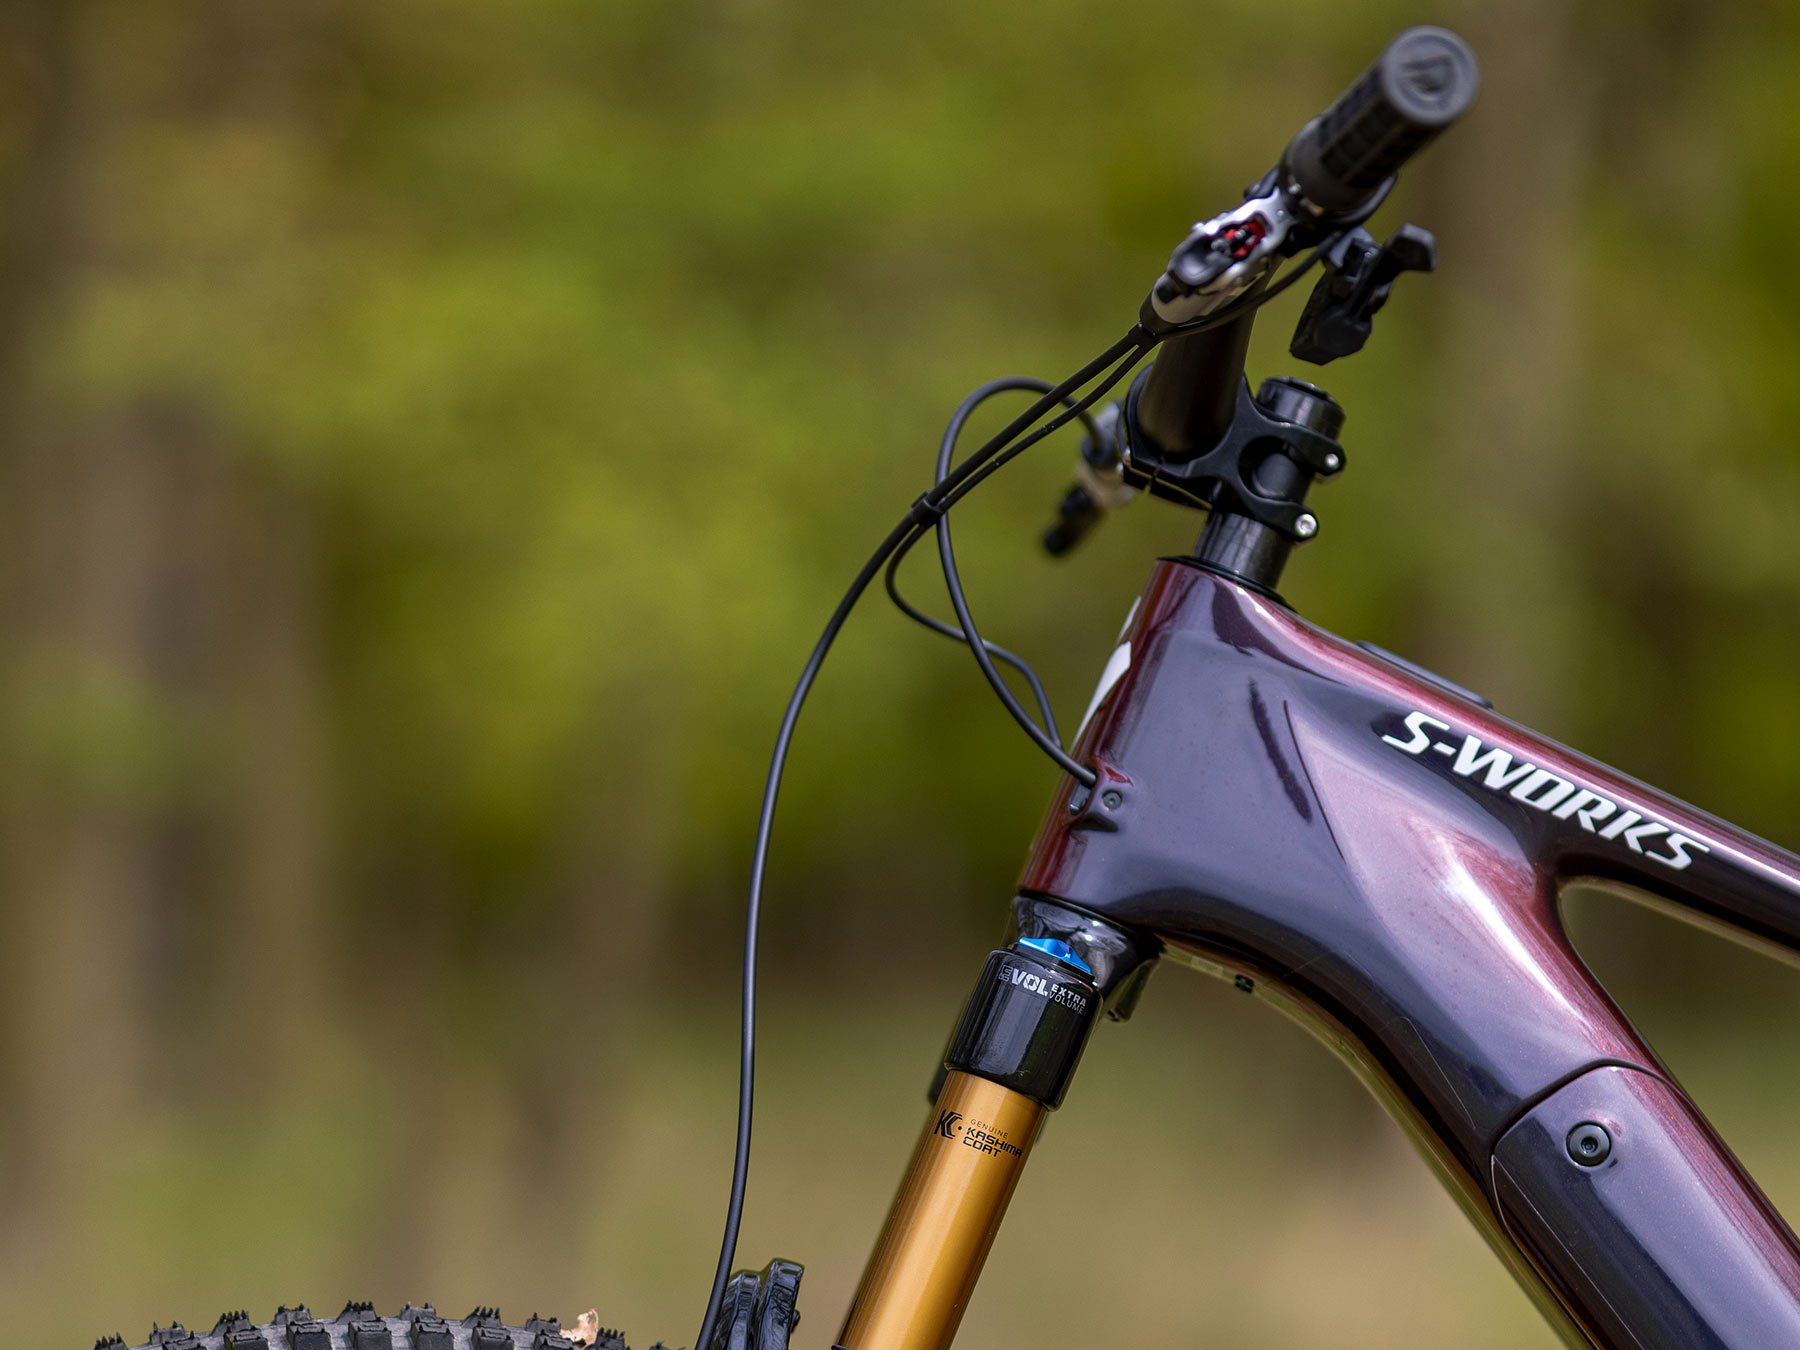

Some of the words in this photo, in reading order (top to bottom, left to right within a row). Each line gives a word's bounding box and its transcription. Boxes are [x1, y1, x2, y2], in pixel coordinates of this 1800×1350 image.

[1381, 710, 1710, 870] S-WORKS
[999, 964, 1048, 997] EVOL
[1049, 991, 1086, 1015] VOLUME
[1051, 983, 1087, 1007] EXTRA
[970, 1118, 1009, 1140] GENUINE
[963, 1136, 1001, 1157] COAT
[966, 1127, 1023, 1158] KASHIMA
